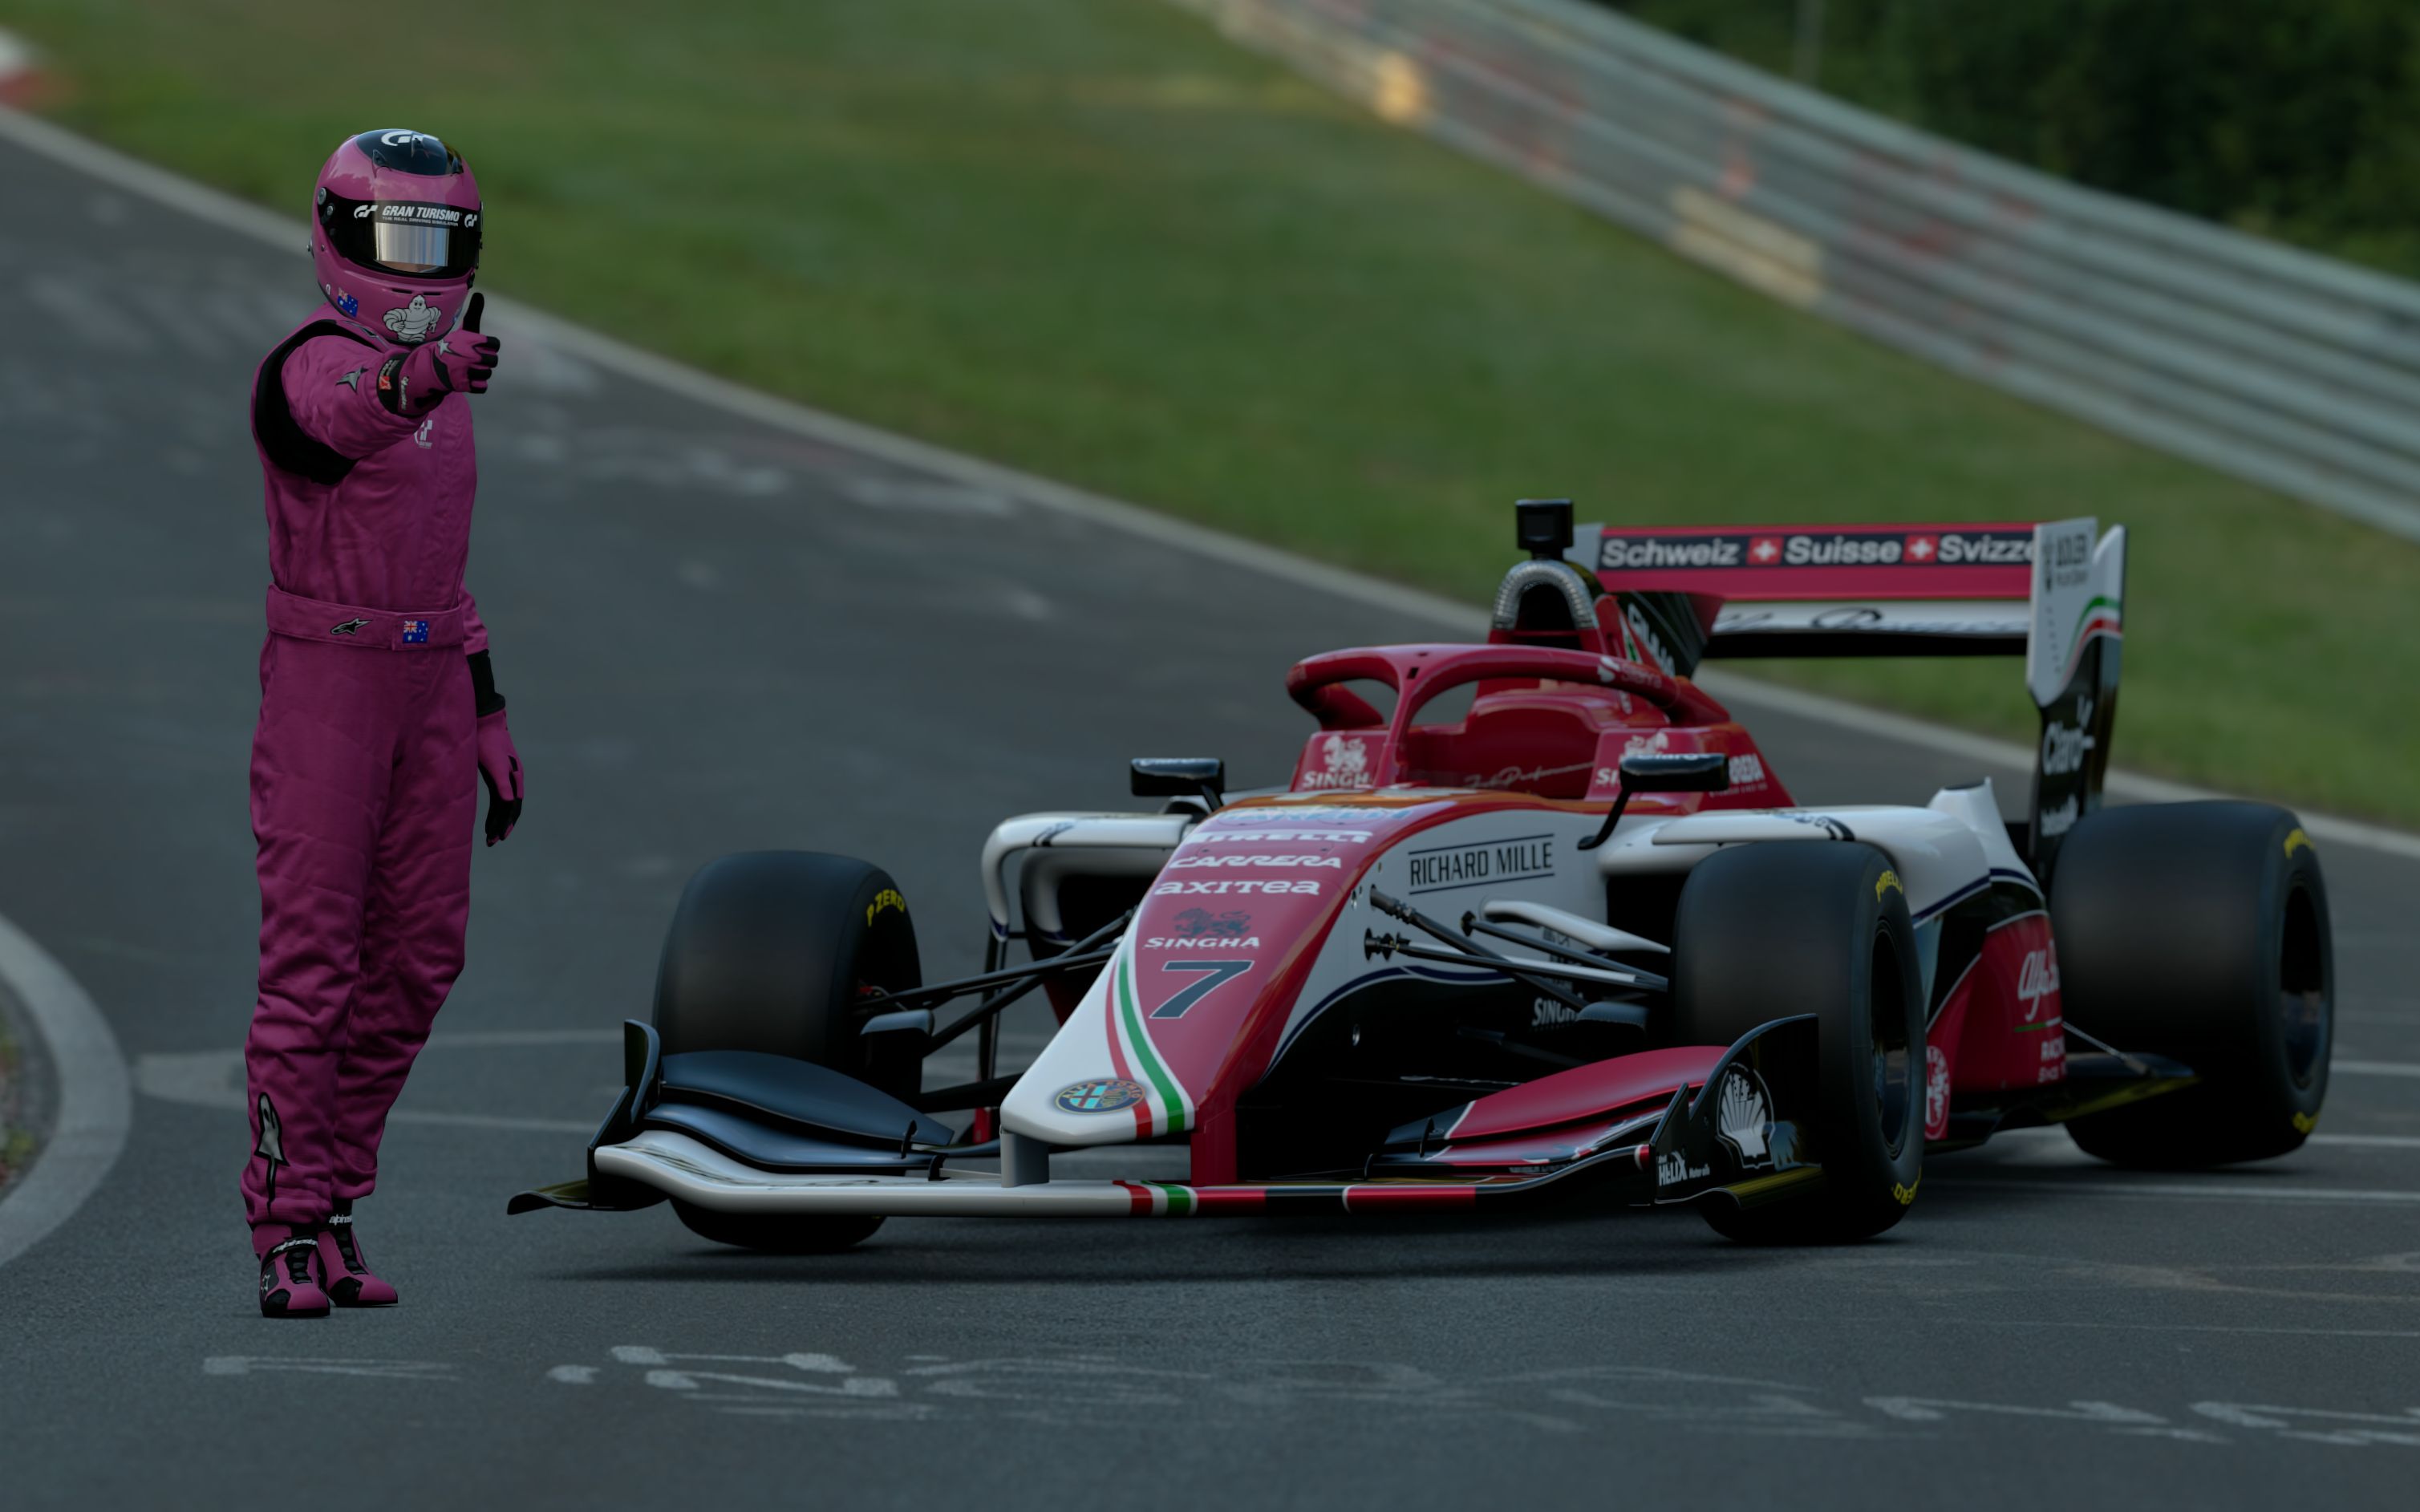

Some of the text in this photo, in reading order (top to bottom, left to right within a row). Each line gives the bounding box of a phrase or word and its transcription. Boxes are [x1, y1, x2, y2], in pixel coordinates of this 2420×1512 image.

[382, 205, 460, 222] GRAN TURISMO
[1601, 537, 1741, 568] Schweiz
[1783, 535, 1903, 565] Suisse
[1303, 770, 1371, 789] SINGH
[1168, 854, 1342, 869] CARRERA
[1410, 842, 1553, 886] RICHARD MILLE
[1143, 937, 1260, 949] SINGHA
[1149, 959, 1255, 1019] 7
[1659, 1150, 1688, 1187] HELIX
